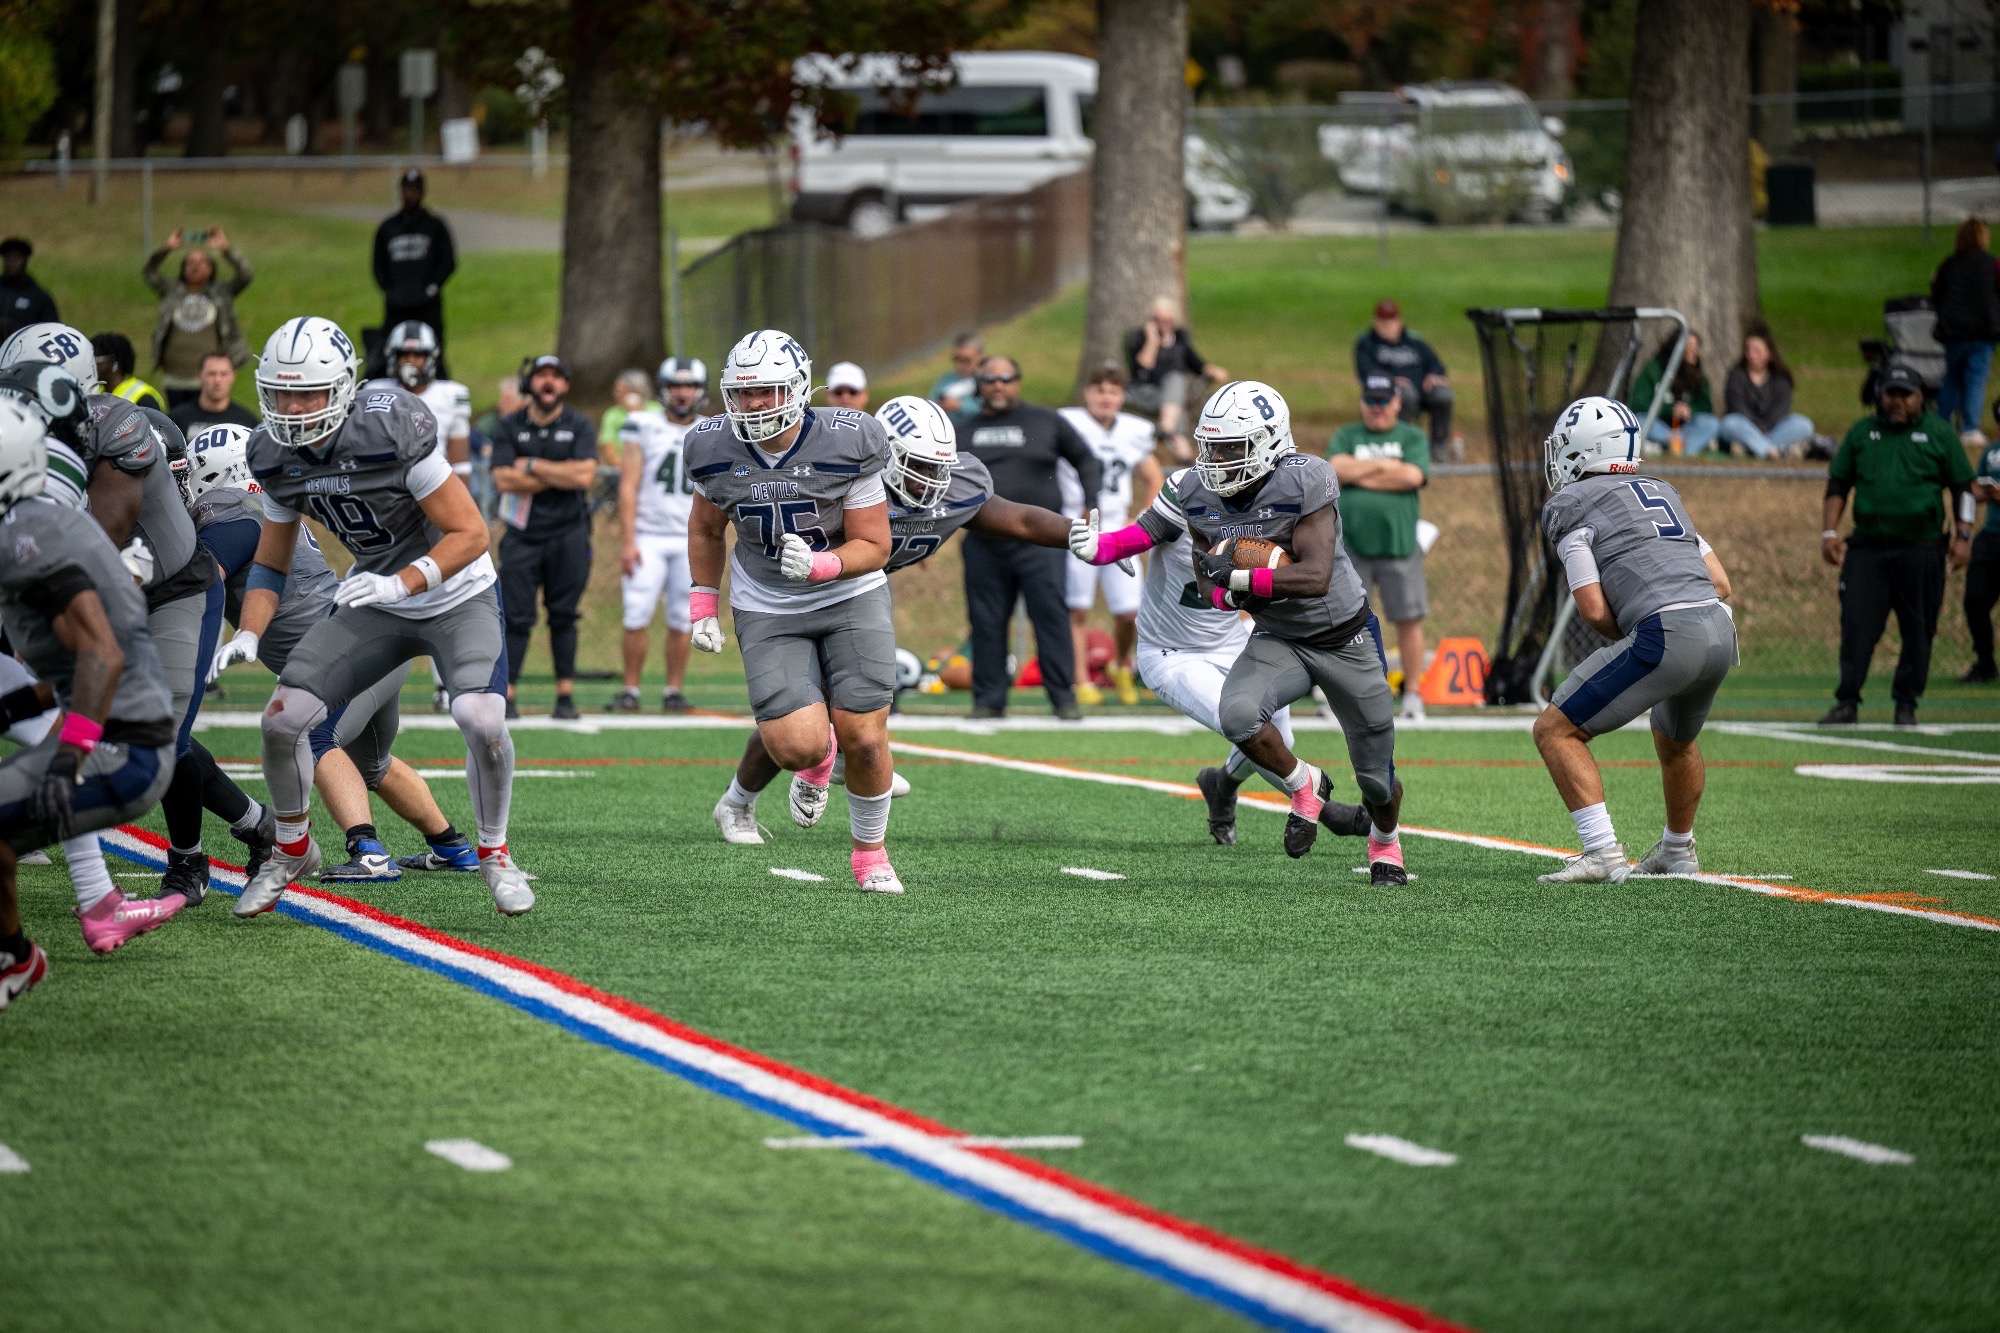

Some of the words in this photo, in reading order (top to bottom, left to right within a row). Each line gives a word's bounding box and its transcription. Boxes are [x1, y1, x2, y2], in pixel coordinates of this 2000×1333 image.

[38, 333, 80, 365] 58
[330, 329, 354, 362] 19
[780, 338, 808, 369] 75
[830, 410, 864, 431] 75
[882, 401, 919, 437] FDU
[1252, 395, 1275, 421] 8
[195, 429, 228, 453] 60
[305, 474, 350, 495] DEVILS
[751, 481, 798, 501] DEVILS
[308, 495, 395, 552] 19
[1619, 479, 1686, 538] 5
[737, 499, 830, 560] 75
[892, 520, 936, 534] DEVILS
[1221, 525, 1263, 540] DEVILS
[1444, 649, 1485, 694] 20
